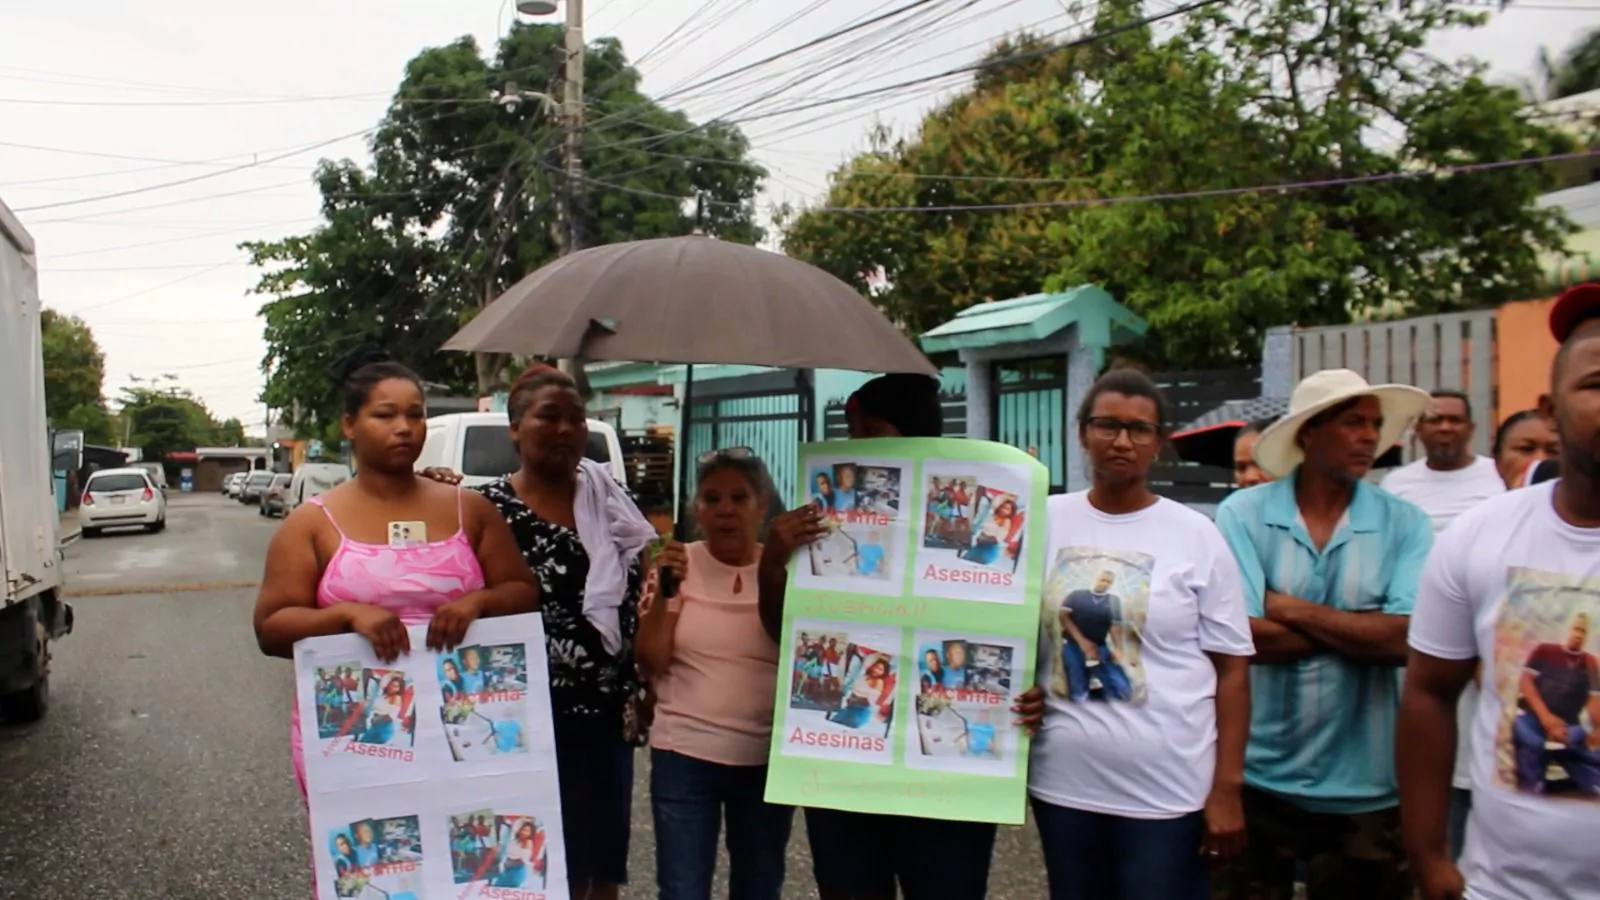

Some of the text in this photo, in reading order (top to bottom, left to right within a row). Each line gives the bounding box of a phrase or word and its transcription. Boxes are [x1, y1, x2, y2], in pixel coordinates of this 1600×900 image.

[923, 563, 1014, 586] Asesinas
[789, 726, 885, 752] Asesinas
[344, 740, 414, 762] Asesina
